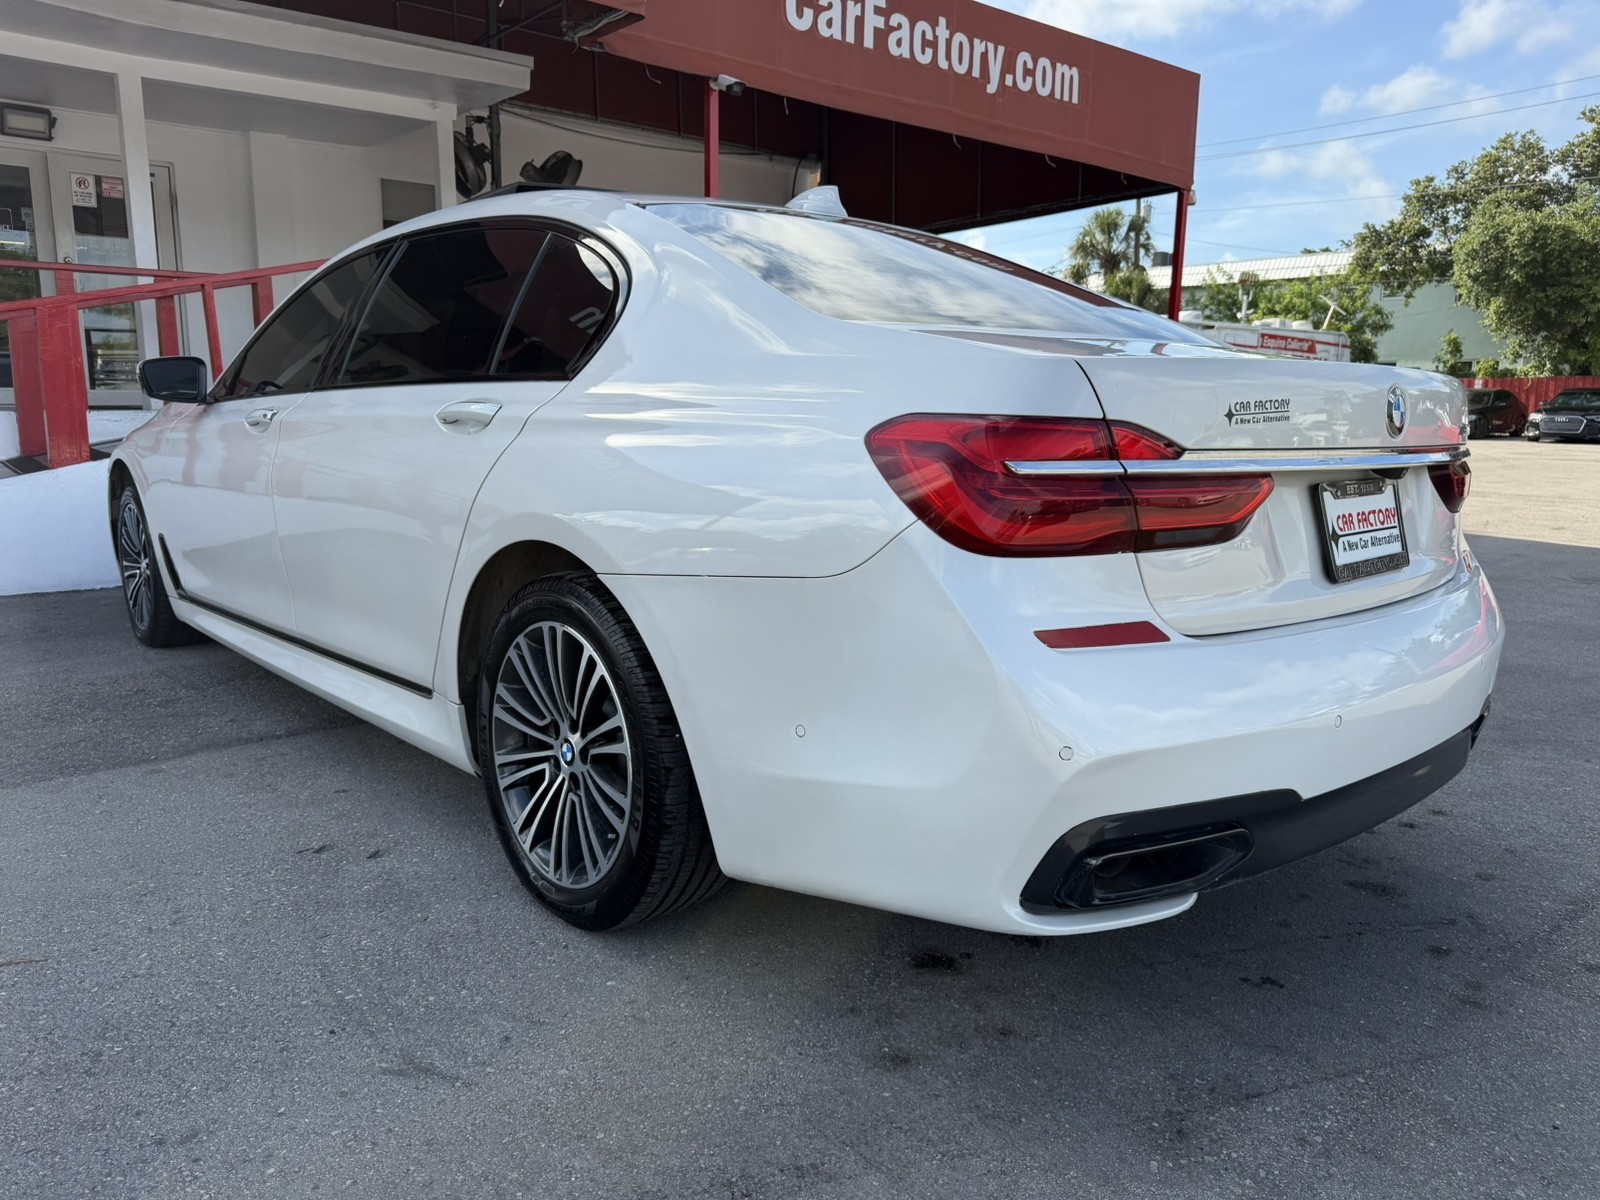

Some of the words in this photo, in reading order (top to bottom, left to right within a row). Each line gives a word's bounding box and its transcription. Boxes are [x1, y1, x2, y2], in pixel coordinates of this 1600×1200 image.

[785, 0, 1079, 105] CarFactory.com
[1234, 401, 1251, 412] CAR
[1254, 398, 1290, 411] FACTORY
[1252, 416, 1261, 424] Car
[1262, 414, 1290, 423] Alternative
[1336, 513, 1355, 532] CAR
[1356, 507, 1396, 530] FACTORY
[1343, 541, 1348, 552] A
[1348, 540, 1359, 552] New
[1359, 538, 1369, 549] Car
[1370, 532, 1400, 548] Alternative
